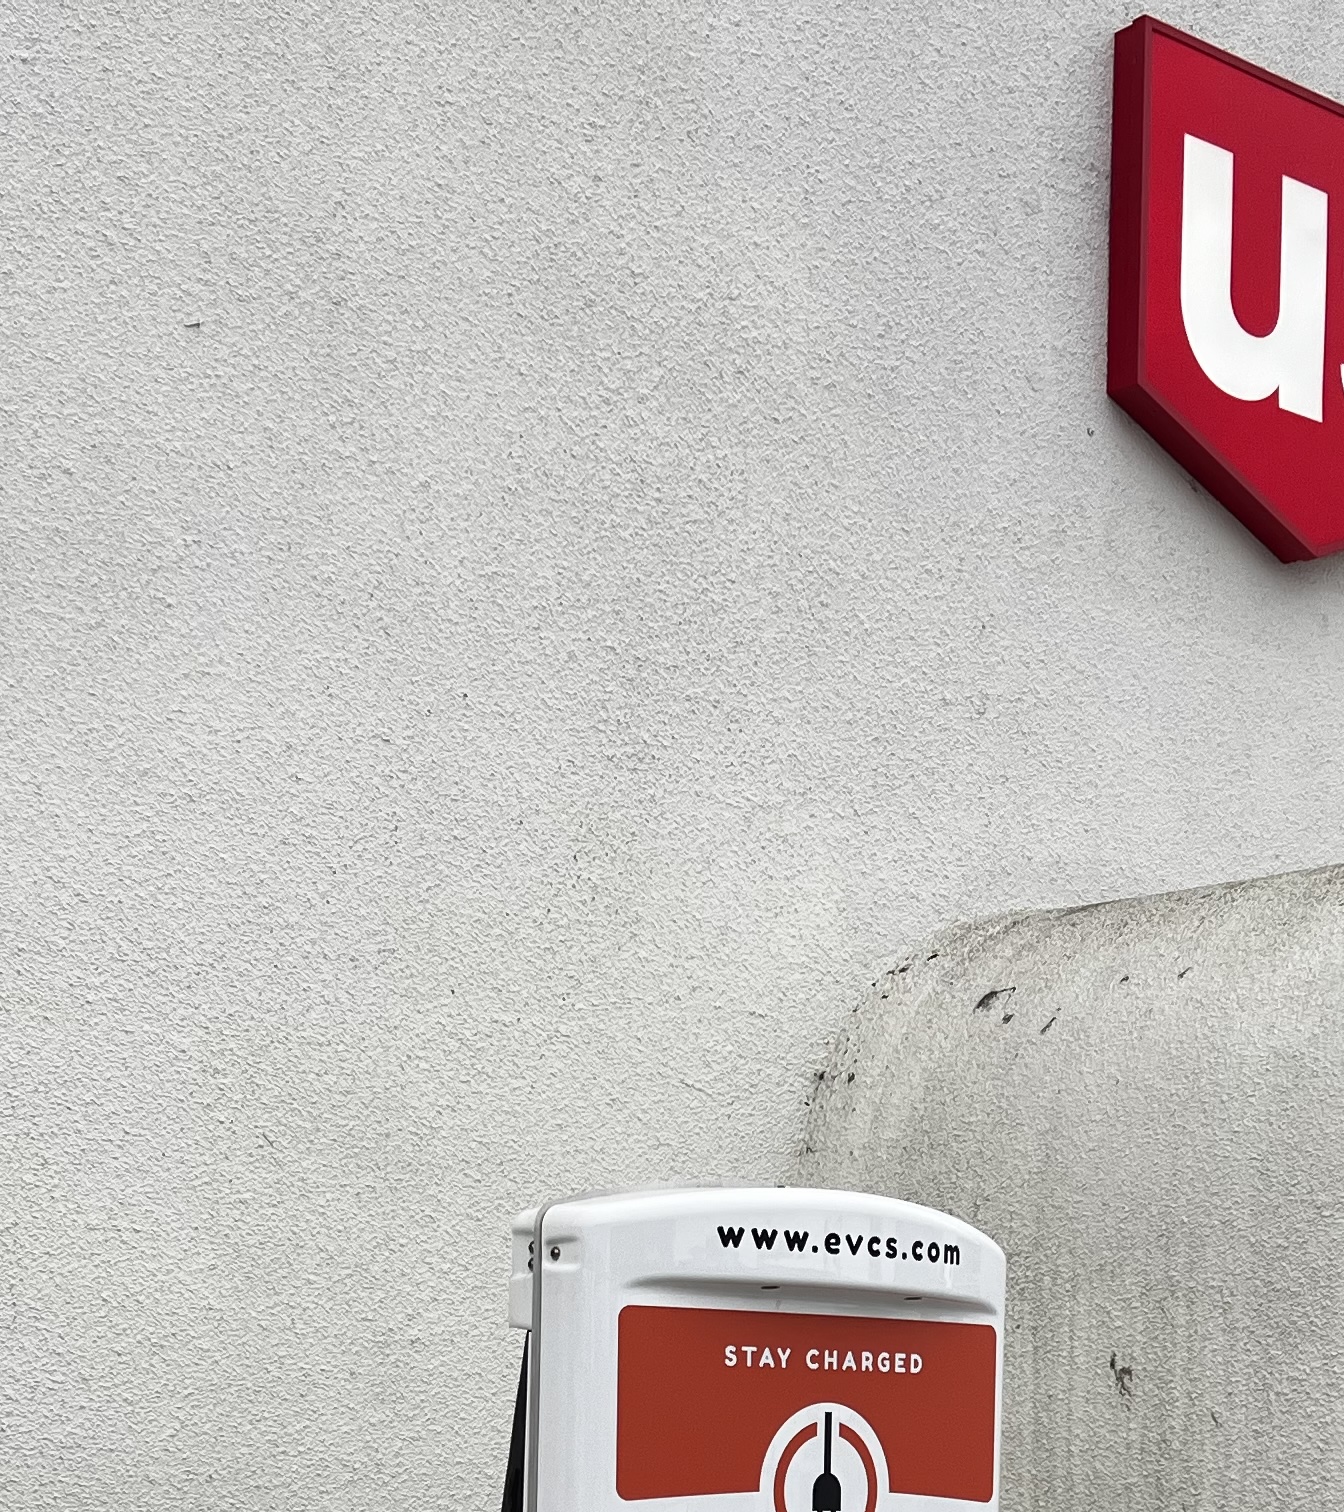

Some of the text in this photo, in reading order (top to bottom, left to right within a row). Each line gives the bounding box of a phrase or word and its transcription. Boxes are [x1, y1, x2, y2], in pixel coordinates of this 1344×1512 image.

[717, 1224, 962, 1266] www.evcs.com
[724, 1345, 924, 1374] STAY CHARGED
